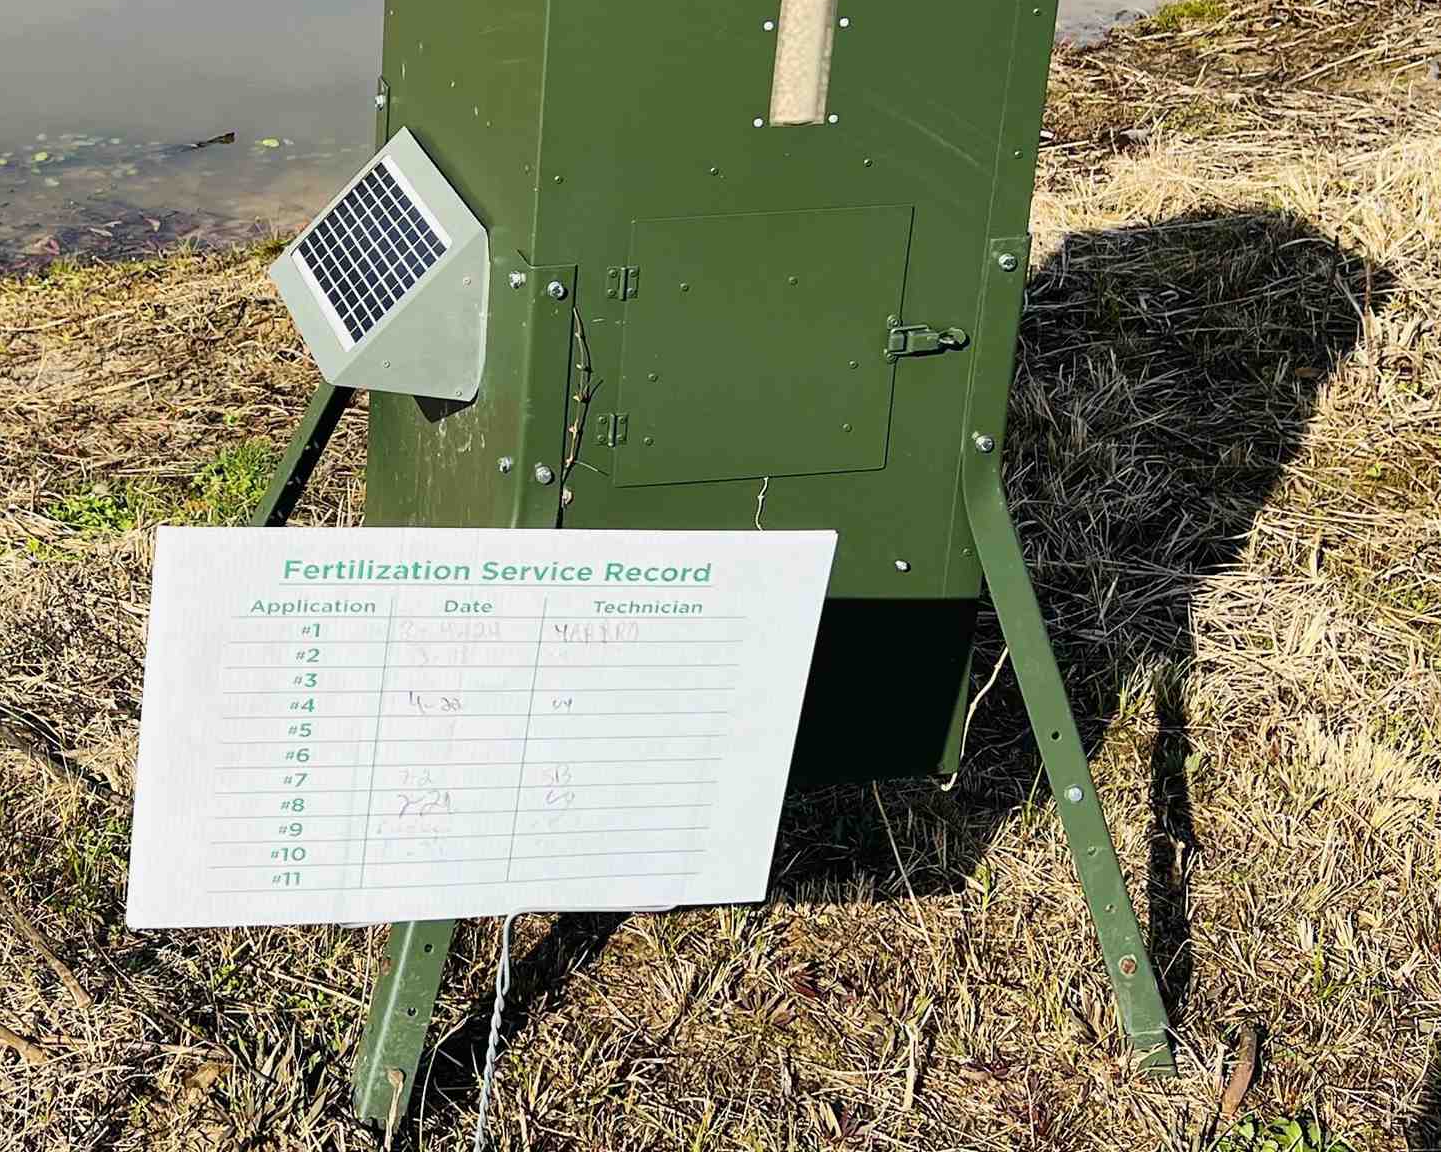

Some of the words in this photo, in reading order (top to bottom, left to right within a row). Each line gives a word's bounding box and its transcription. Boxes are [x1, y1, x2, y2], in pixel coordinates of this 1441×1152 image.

[282, 559, 471, 581] Fertilization
[481, 561, 594, 582] Service
[604, 562, 712, 583] Record
[250, 599, 377, 616] Application
[443, 599, 494, 614] Date
[593, 600, 704, 615] Technician
[301, 623, 321, 638] #1
[295, 647, 320, 663] #2
[293, 672, 318, 688] #3
[289, 698, 315, 713] #4
[287, 722, 312, 738] #5
[285, 747, 310, 763] #6
[283, 772, 308, 788] #7
[279, 798, 305, 813] #8
[278, 822, 303, 838] #9
[270, 846, 307, 862] #10
[271, 871, 301, 887] #11
